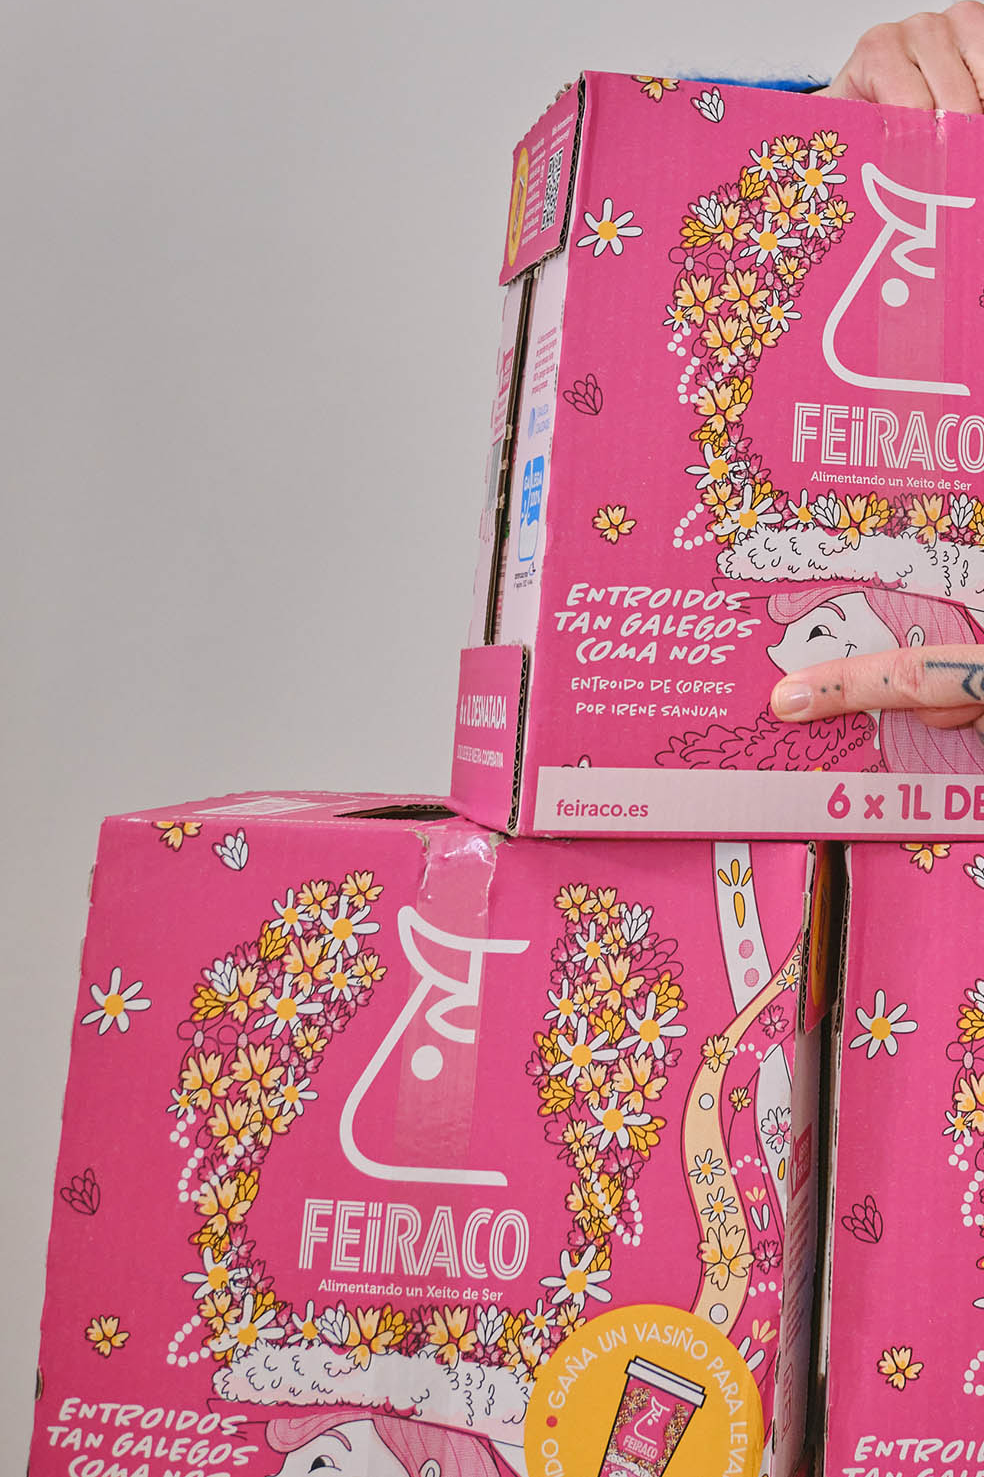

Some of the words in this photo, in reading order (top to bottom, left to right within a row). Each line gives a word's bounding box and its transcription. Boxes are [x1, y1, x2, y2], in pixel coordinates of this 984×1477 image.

[810, 470, 886, 486] Alimentando
[888, 478, 904, 487] un
[905, 475, 936, 489] Xeito
[937, 478, 952, 490] de
[953, 480, 972, 491] Ser
[566, 582, 750, 611] ENTROIDOS
[554, 611, 612, 634] TAN
[620, 612, 761, 640] GALEGOS
[575, 637, 658, 664] COMA
[669, 634, 735, 665] NÓS
[571, 676, 644, 692] ENTROIDO
[650, 679, 671, 694] DE
[675, 679, 735, 695] COBRES
[575, 702, 606, 716] POR
[611, 703, 657, 717] IRENE
[661, 704, 728, 718] SANJUAN
[556, 798, 649, 818] feiraco.es
[827, 782, 851, 820] 6
[863, 794, 885, 820] x
[898, 783, 932, 821] 1L
[318, 1278, 403, 1297] Alimentando
[405, 1287, 423, 1298] un
[427, 1285, 460, 1300] Xeito
[462, 1288, 479, 1301] de
[481, 1289, 503, 1302] Ser
[597, 1325, 628, 1354] UN
[633, 1323, 709, 1360] VASIÑO
[547, 1346, 598, 1410] GAÑA
[706, 1355, 745, 1416] PARA
[58, 1397, 248, 1436] ENTROIDOS
[47, 1426, 104, 1451] TAN
[111, 1432, 259, 1466] GALEGOS
[722, 1421, 748, 1477] LEVA
